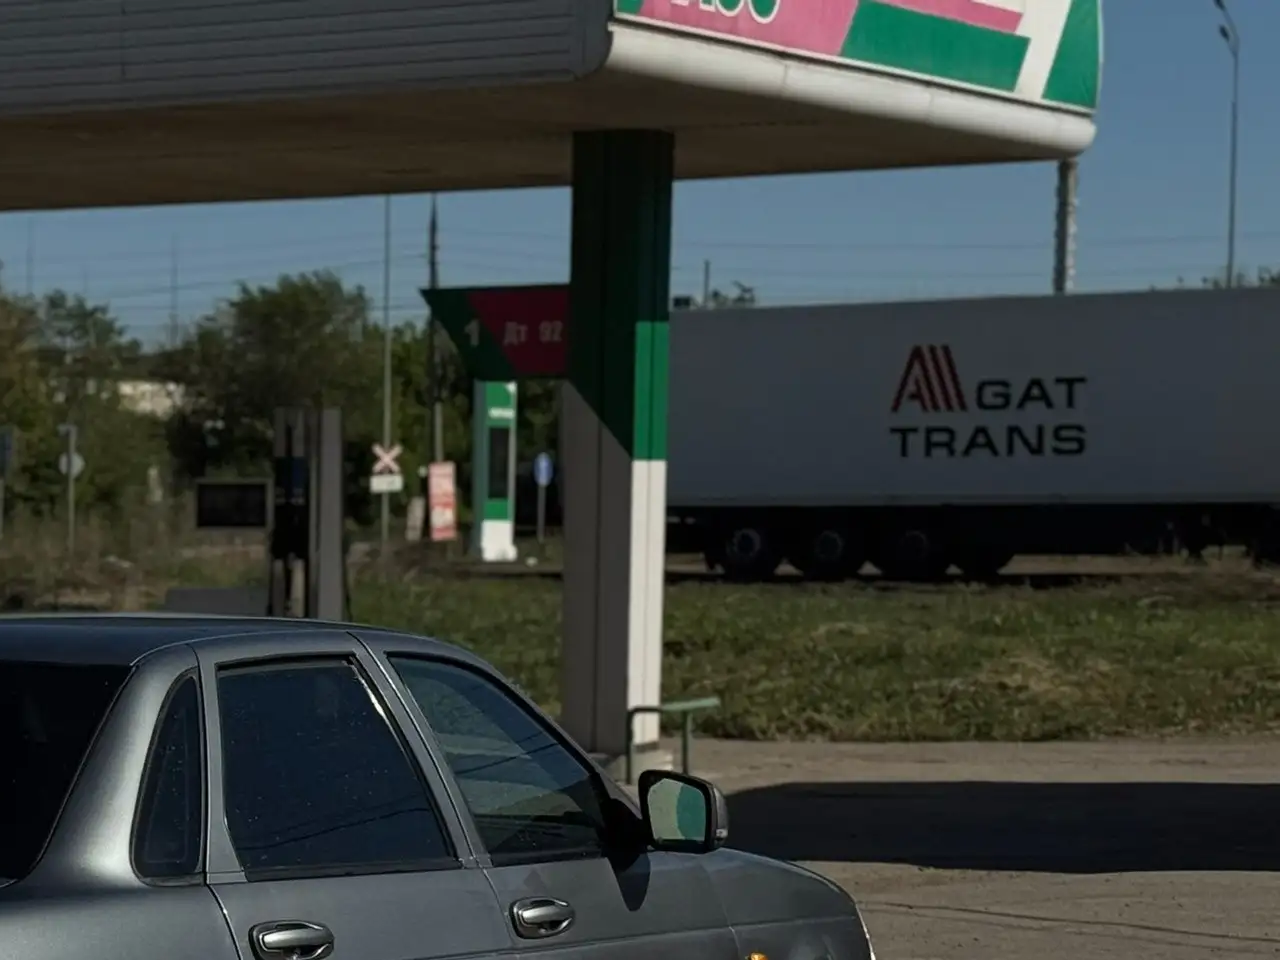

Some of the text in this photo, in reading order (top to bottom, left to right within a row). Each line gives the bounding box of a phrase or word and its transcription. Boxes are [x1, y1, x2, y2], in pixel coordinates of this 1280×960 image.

[464, 319, 480, 348] 1
[538, 319, 564, 343] 92
[889, 423, 1088, 458] TRANS
